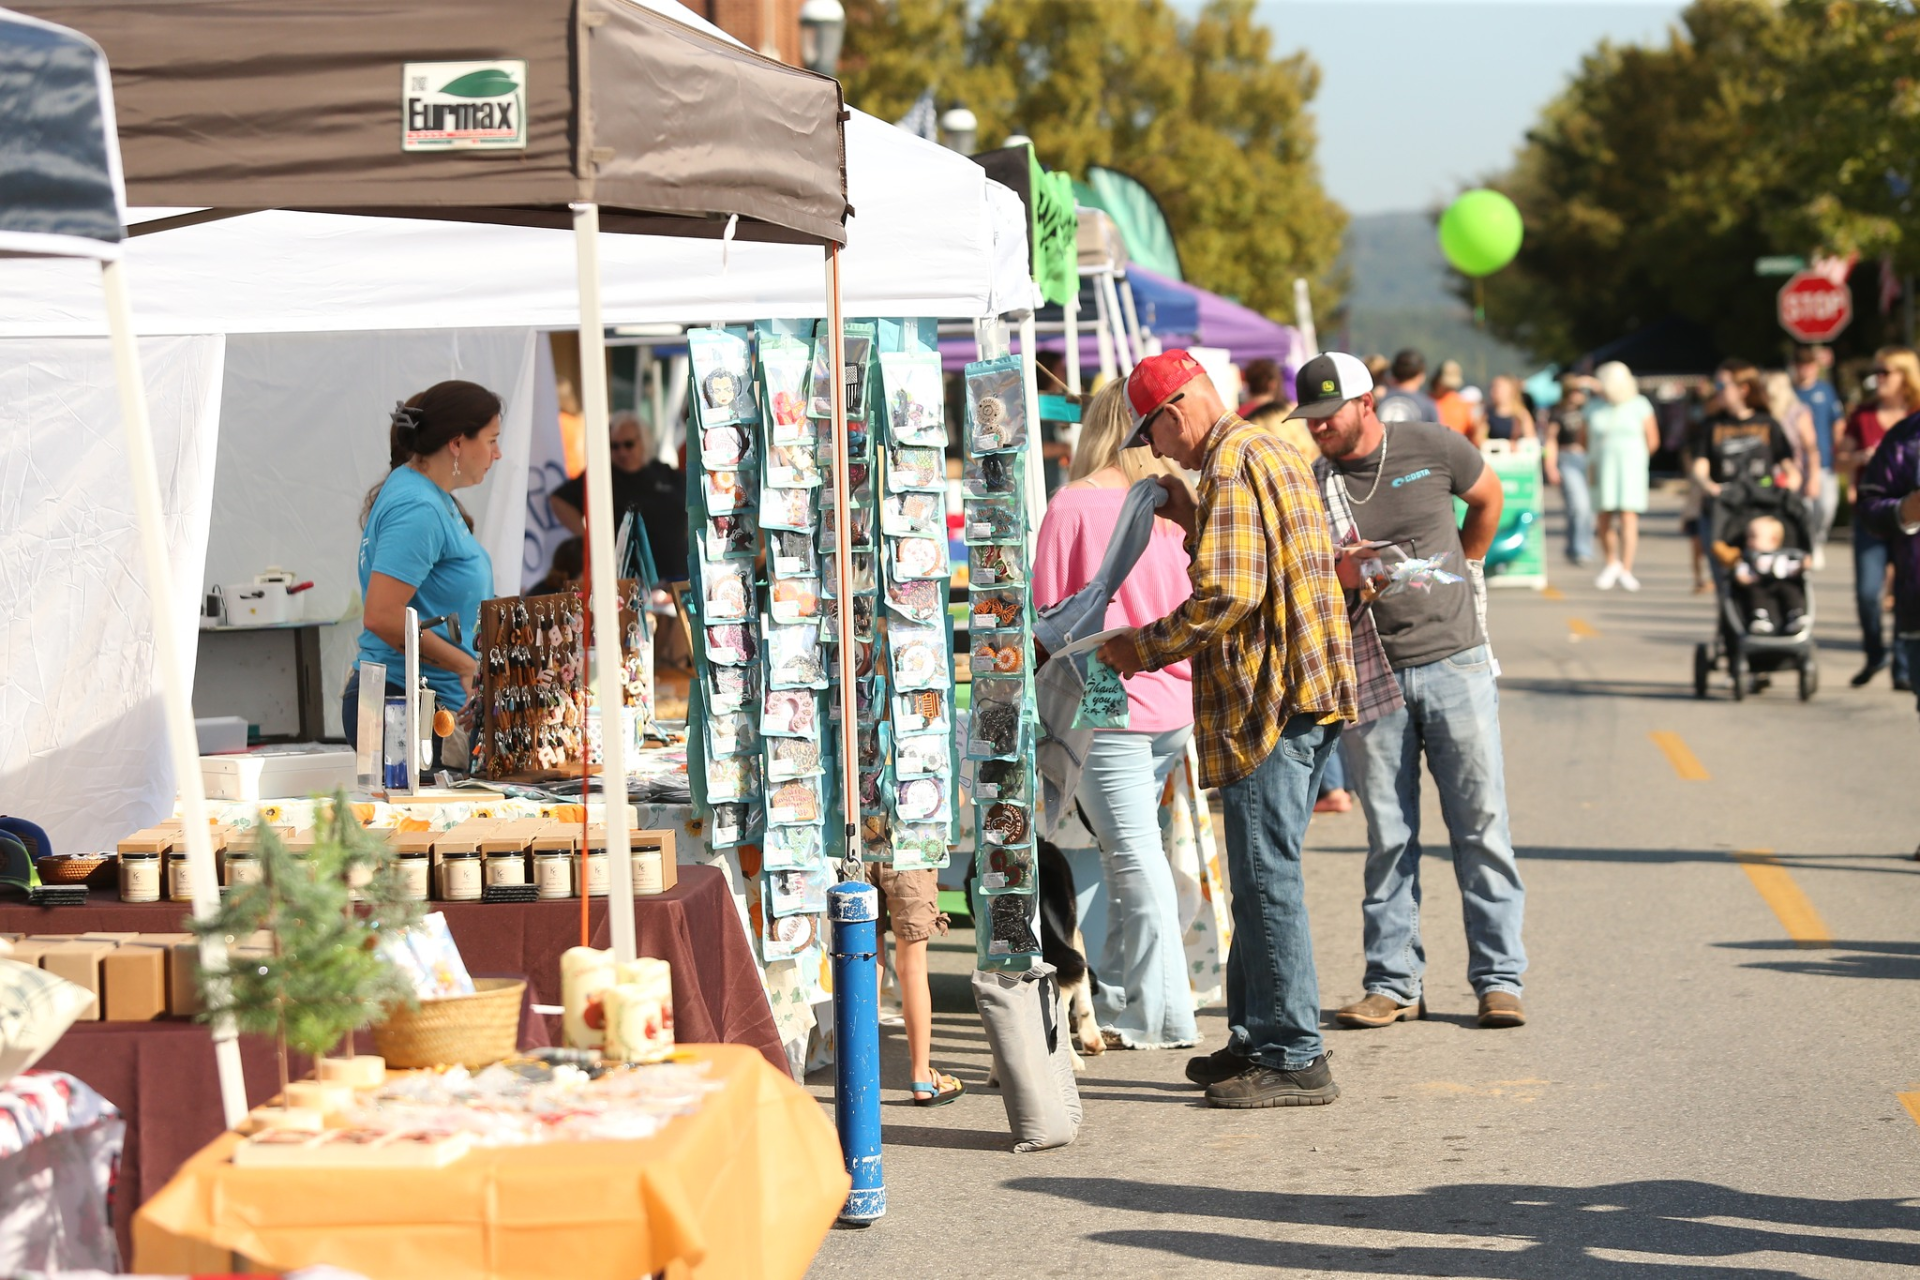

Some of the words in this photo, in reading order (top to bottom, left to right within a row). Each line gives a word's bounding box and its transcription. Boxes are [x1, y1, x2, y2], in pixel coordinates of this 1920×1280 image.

[408, 98, 512, 131] Eurmax
[1783, 291, 1845, 321] STOP
[1405, 469, 1431, 482] COSTA
[1086, 682, 1118, 694] Thank
[1093, 696, 1111, 706] you
